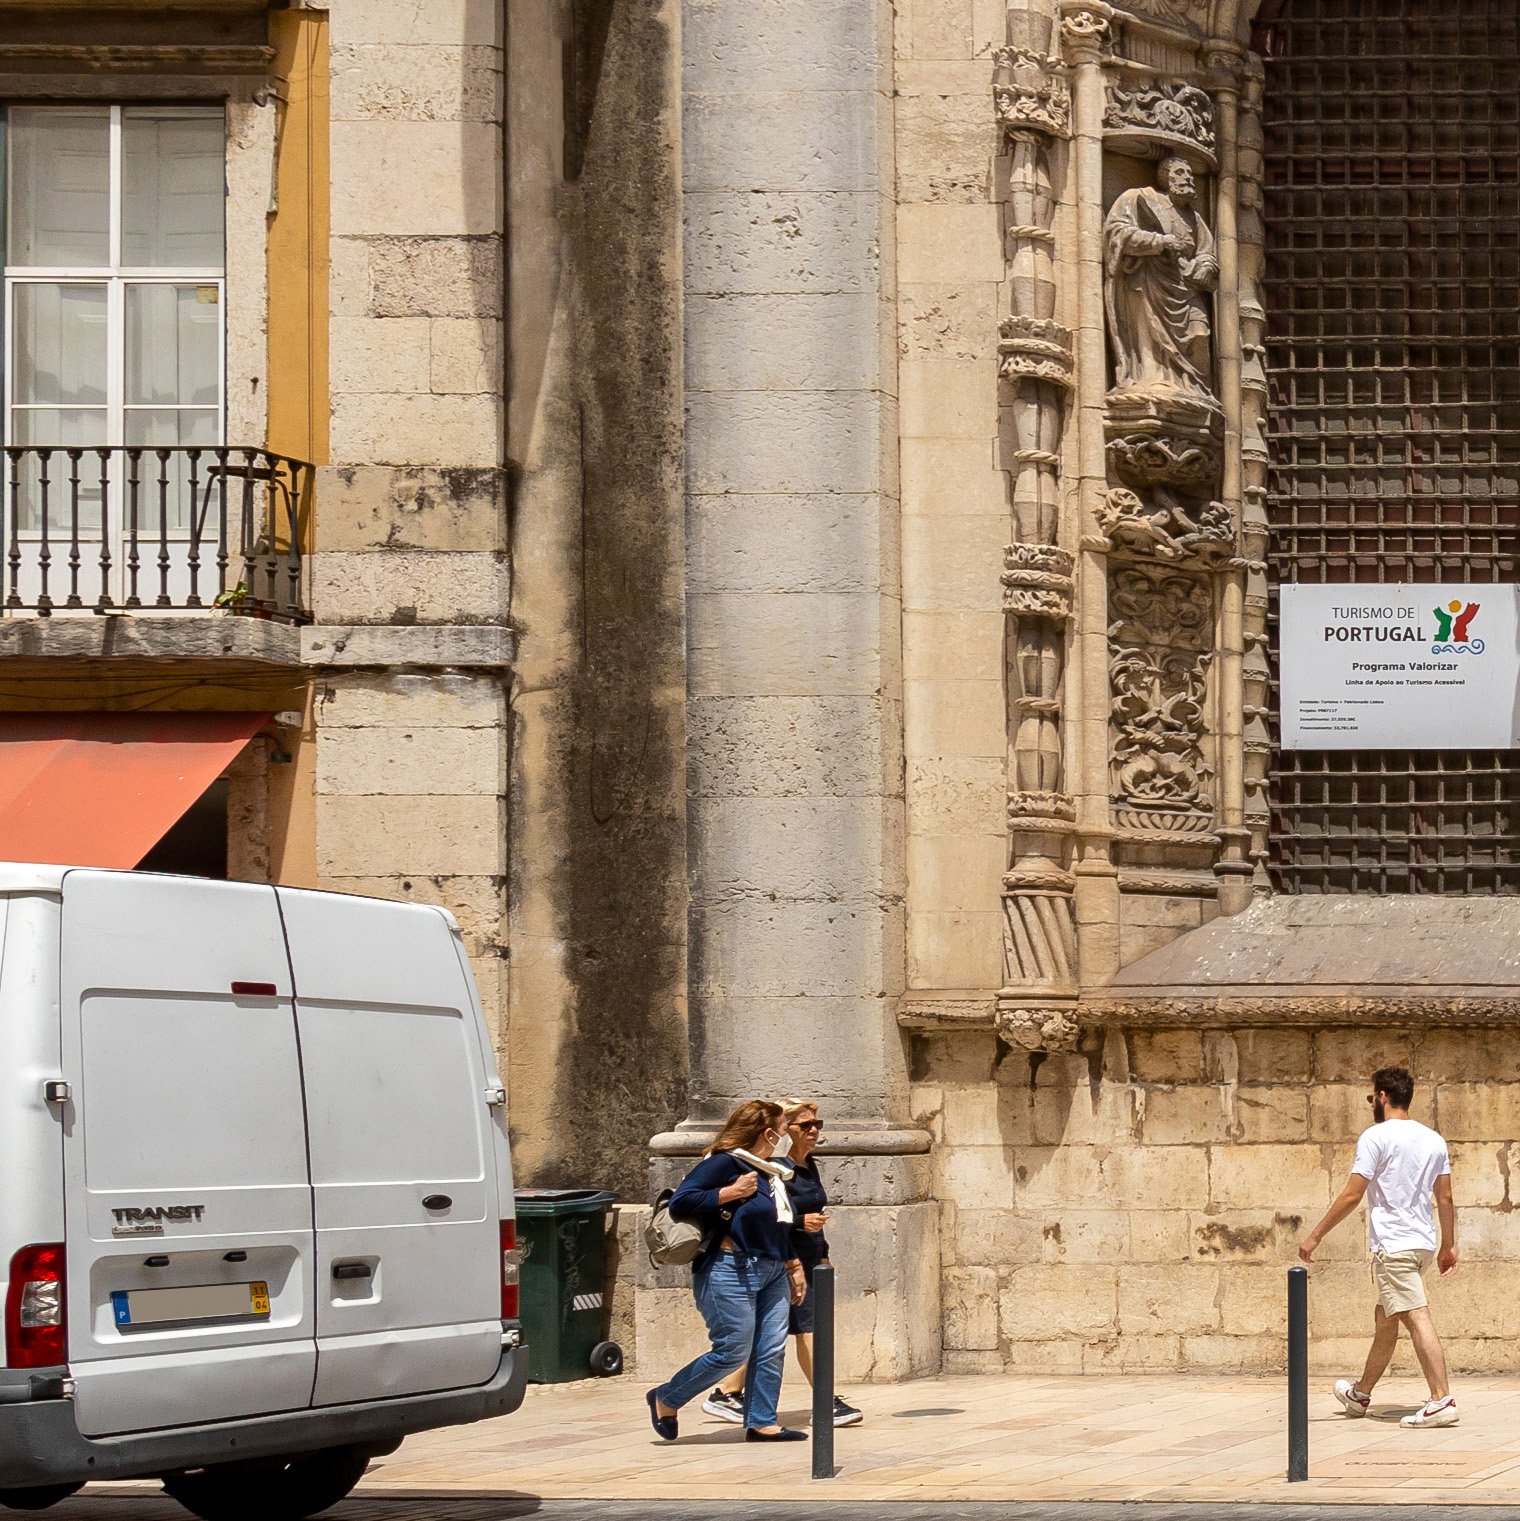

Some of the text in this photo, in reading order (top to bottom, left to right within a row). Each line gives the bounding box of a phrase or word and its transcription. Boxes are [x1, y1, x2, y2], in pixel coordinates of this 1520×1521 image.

[1332, 606, 1415, 619] TURISMO DE
[1324, 626, 1427, 642] PORTUGAL
[1352, 662, 1459, 673] Programa Valorizar
[1375, 679, 1394, 687] Apoio
[111, 1205, 205, 1220] TRANSIT
[256, 1301, 267, 1309] 04
[119, 1311, 127, 1319] P
